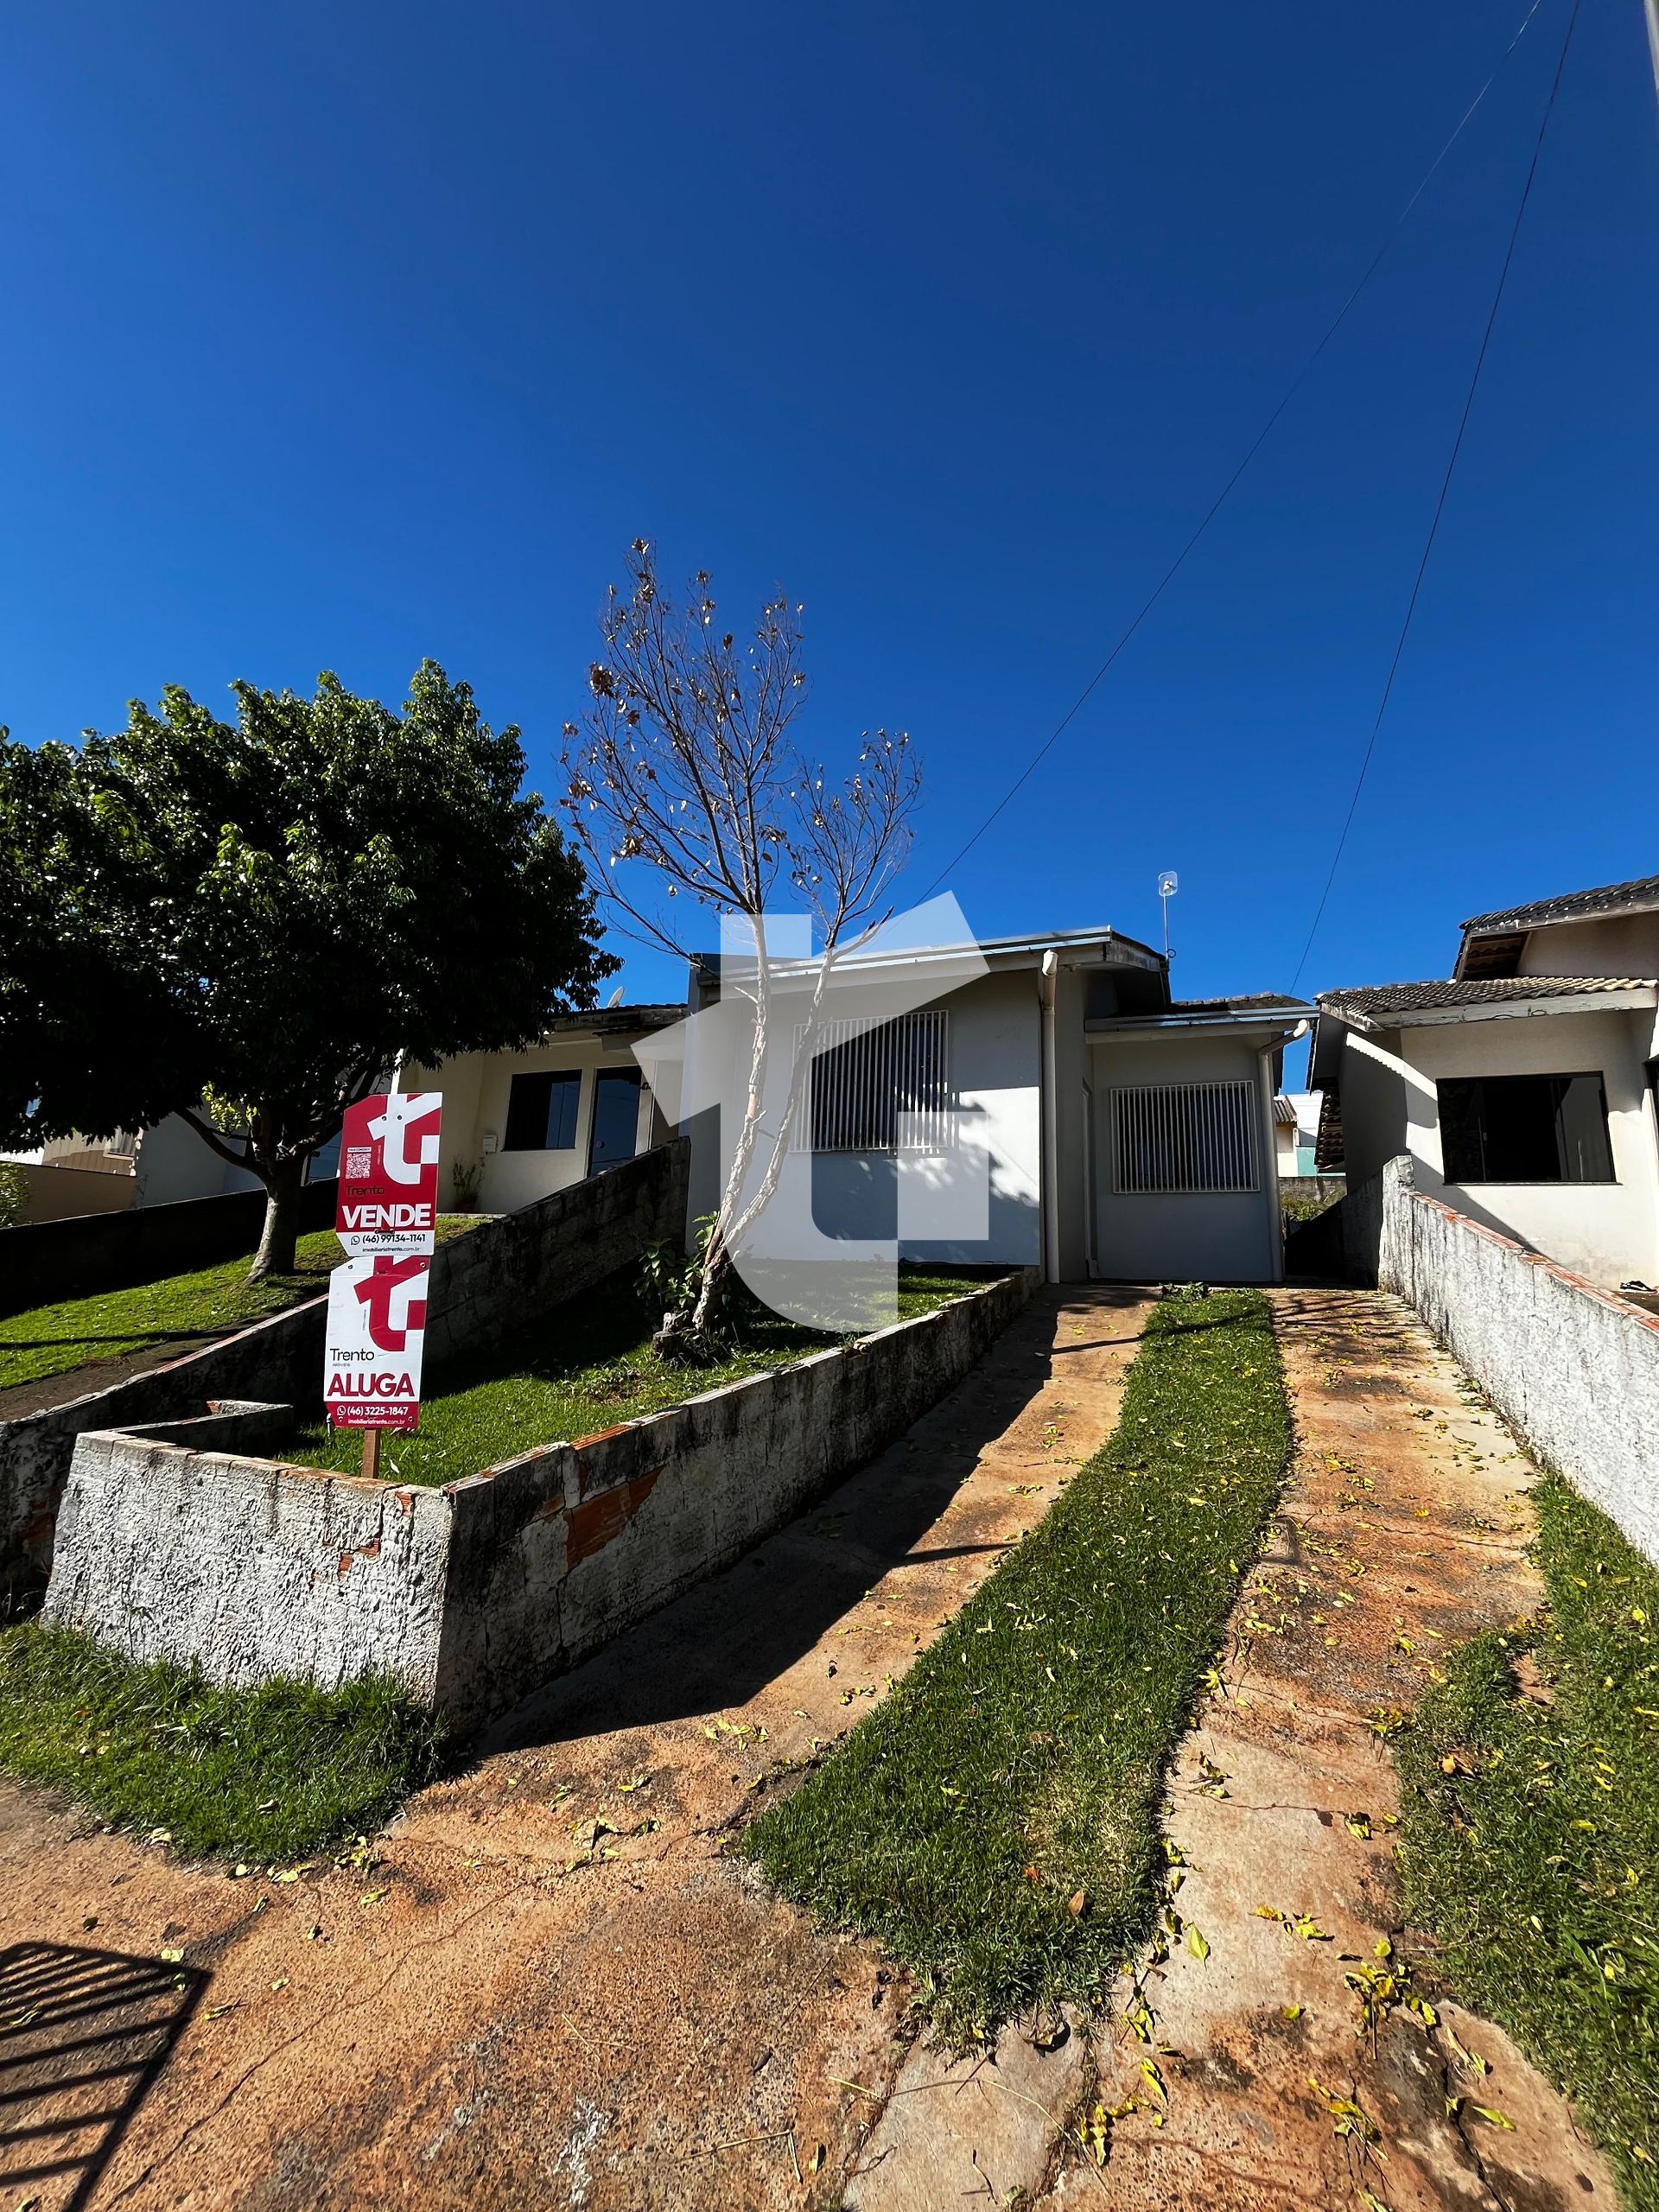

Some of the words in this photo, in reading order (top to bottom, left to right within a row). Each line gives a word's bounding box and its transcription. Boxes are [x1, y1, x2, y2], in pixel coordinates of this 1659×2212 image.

[346, 1185, 385, 1196] Trento
[342, 1204, 431, 1228] VENDE
[362, 1235, 379, 1244] (46)
[381, 1234, 426, 1243] 99134-1141
[329, 1348, 375, 1361] Trento
[327, 1372, 415, 1397] ALUGA
[347, 1406, 364, 1416] (46)
[365, 1406, 409, 1416] 3225-1847
